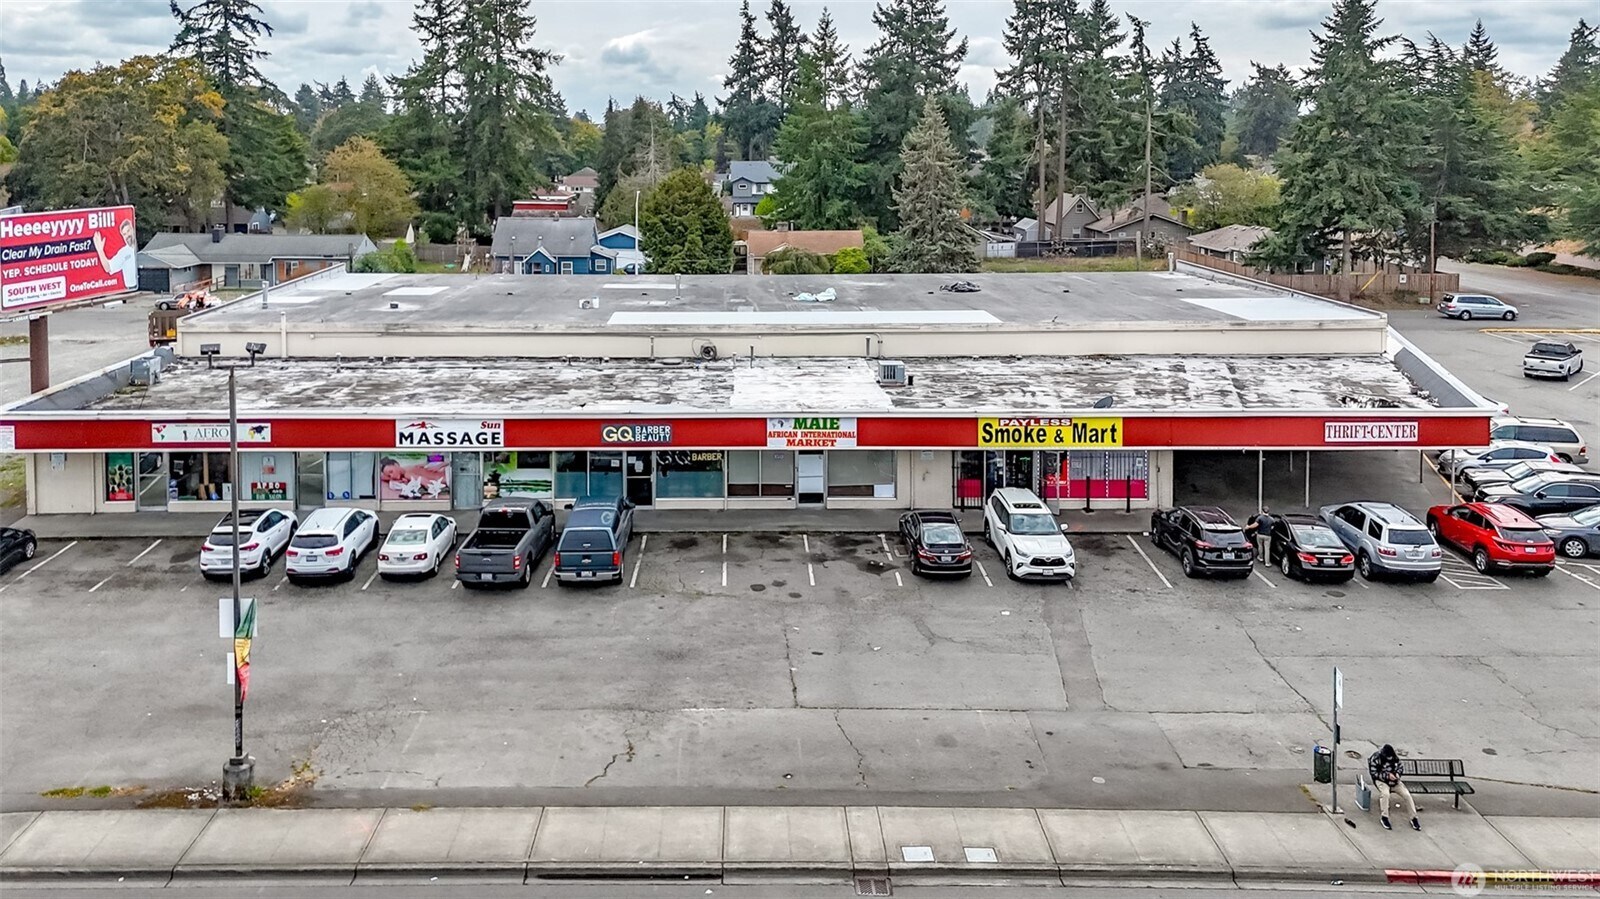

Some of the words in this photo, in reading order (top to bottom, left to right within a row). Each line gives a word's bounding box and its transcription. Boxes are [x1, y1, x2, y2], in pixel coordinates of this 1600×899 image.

[0, 218, 84, 238] Heeeeyyyy
[88, 212, 115, 230] Bill!
[2, 249, 27, 260] Clear
[28, 247, 42, 258] My
[44, 244, 68, 254] Drain
[69, 240, 91, 251] Fast?
[3, 269, 22, 278] YEP.
[24, 262, 68, 275] SCHEDULE
[70, 258, 98, 269] TODAY!
[8, 285, 37, 297] SOUTH
[39, 281, 62, 291] WEST
[69, 279, 118, 292] OneToCall.com
[480, 421, 501, 429] Sun
[793, 418, 840, 430] MAIE
[399, 432, 501, 445] MASSAGE
[603, 426, 634, 442] GQ
[635, 426, 671, 434] BARBER
[635, 434, 671, 442] BEAUTY
[982, 423, 1047, 443] Smoke
[1054, 429, 1064, 443] &
[1072, 423, 1117, 443] Mart
[1326, 424, 1417, 439] THRIFT-CENTER
[786, 439, 837, 447] MARKET
[692, 453, 722, 461] BARBER
